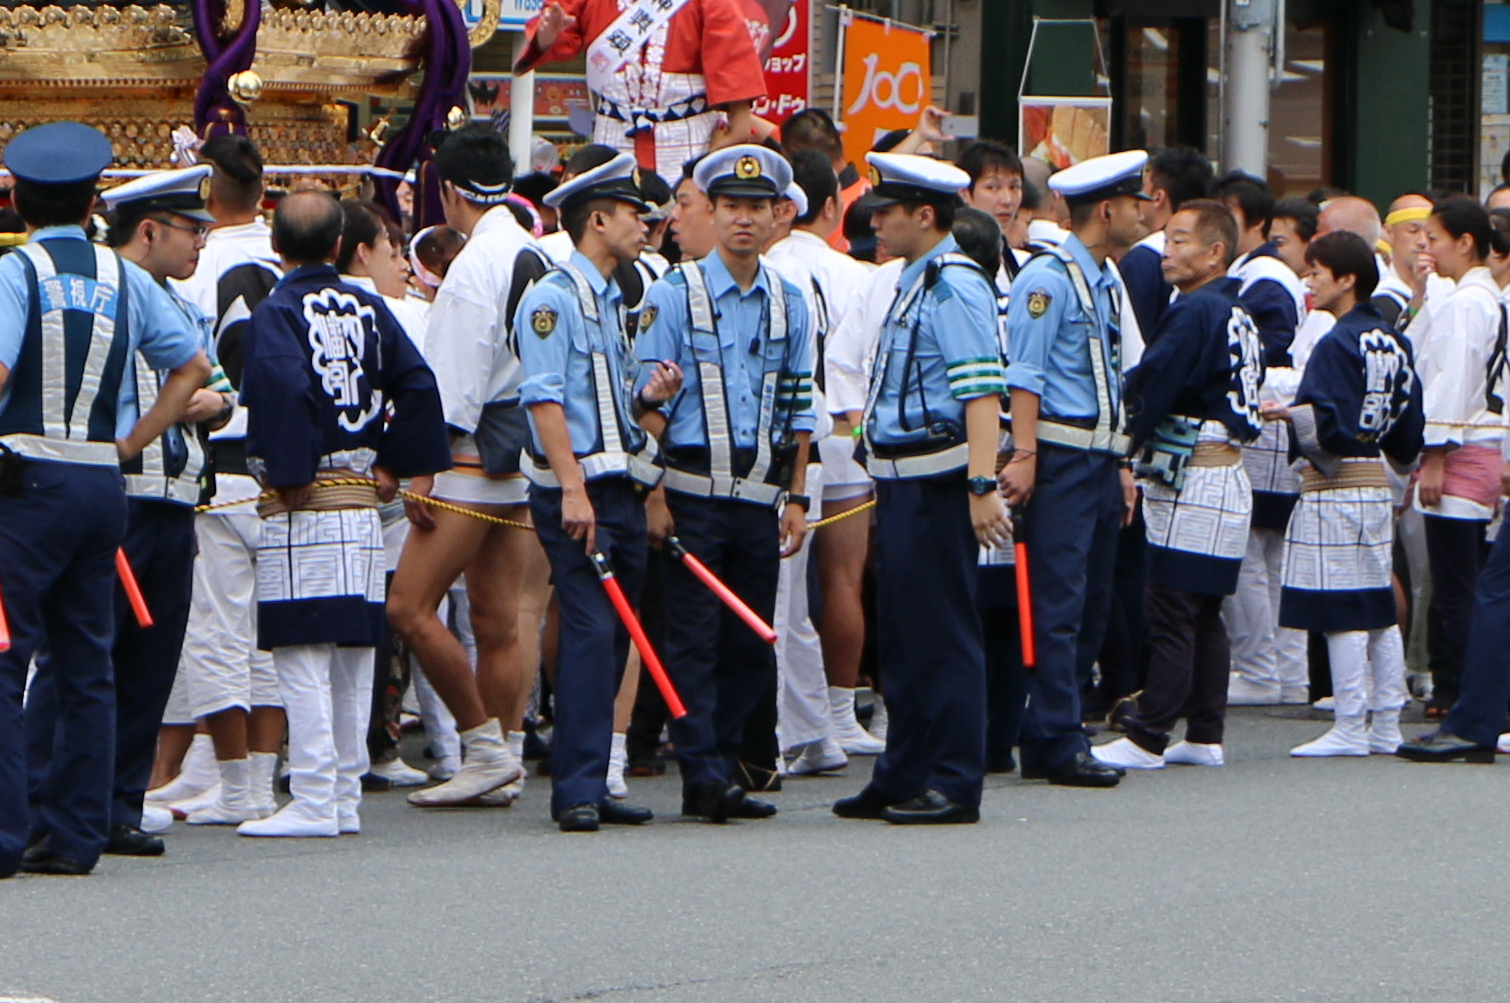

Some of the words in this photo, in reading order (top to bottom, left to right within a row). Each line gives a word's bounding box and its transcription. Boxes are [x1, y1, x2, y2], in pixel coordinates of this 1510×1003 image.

[765, 54, 806, 72] ョップ
[848, 53, 923, 114] 100
[43, 278, 115, 314] 警視庁
